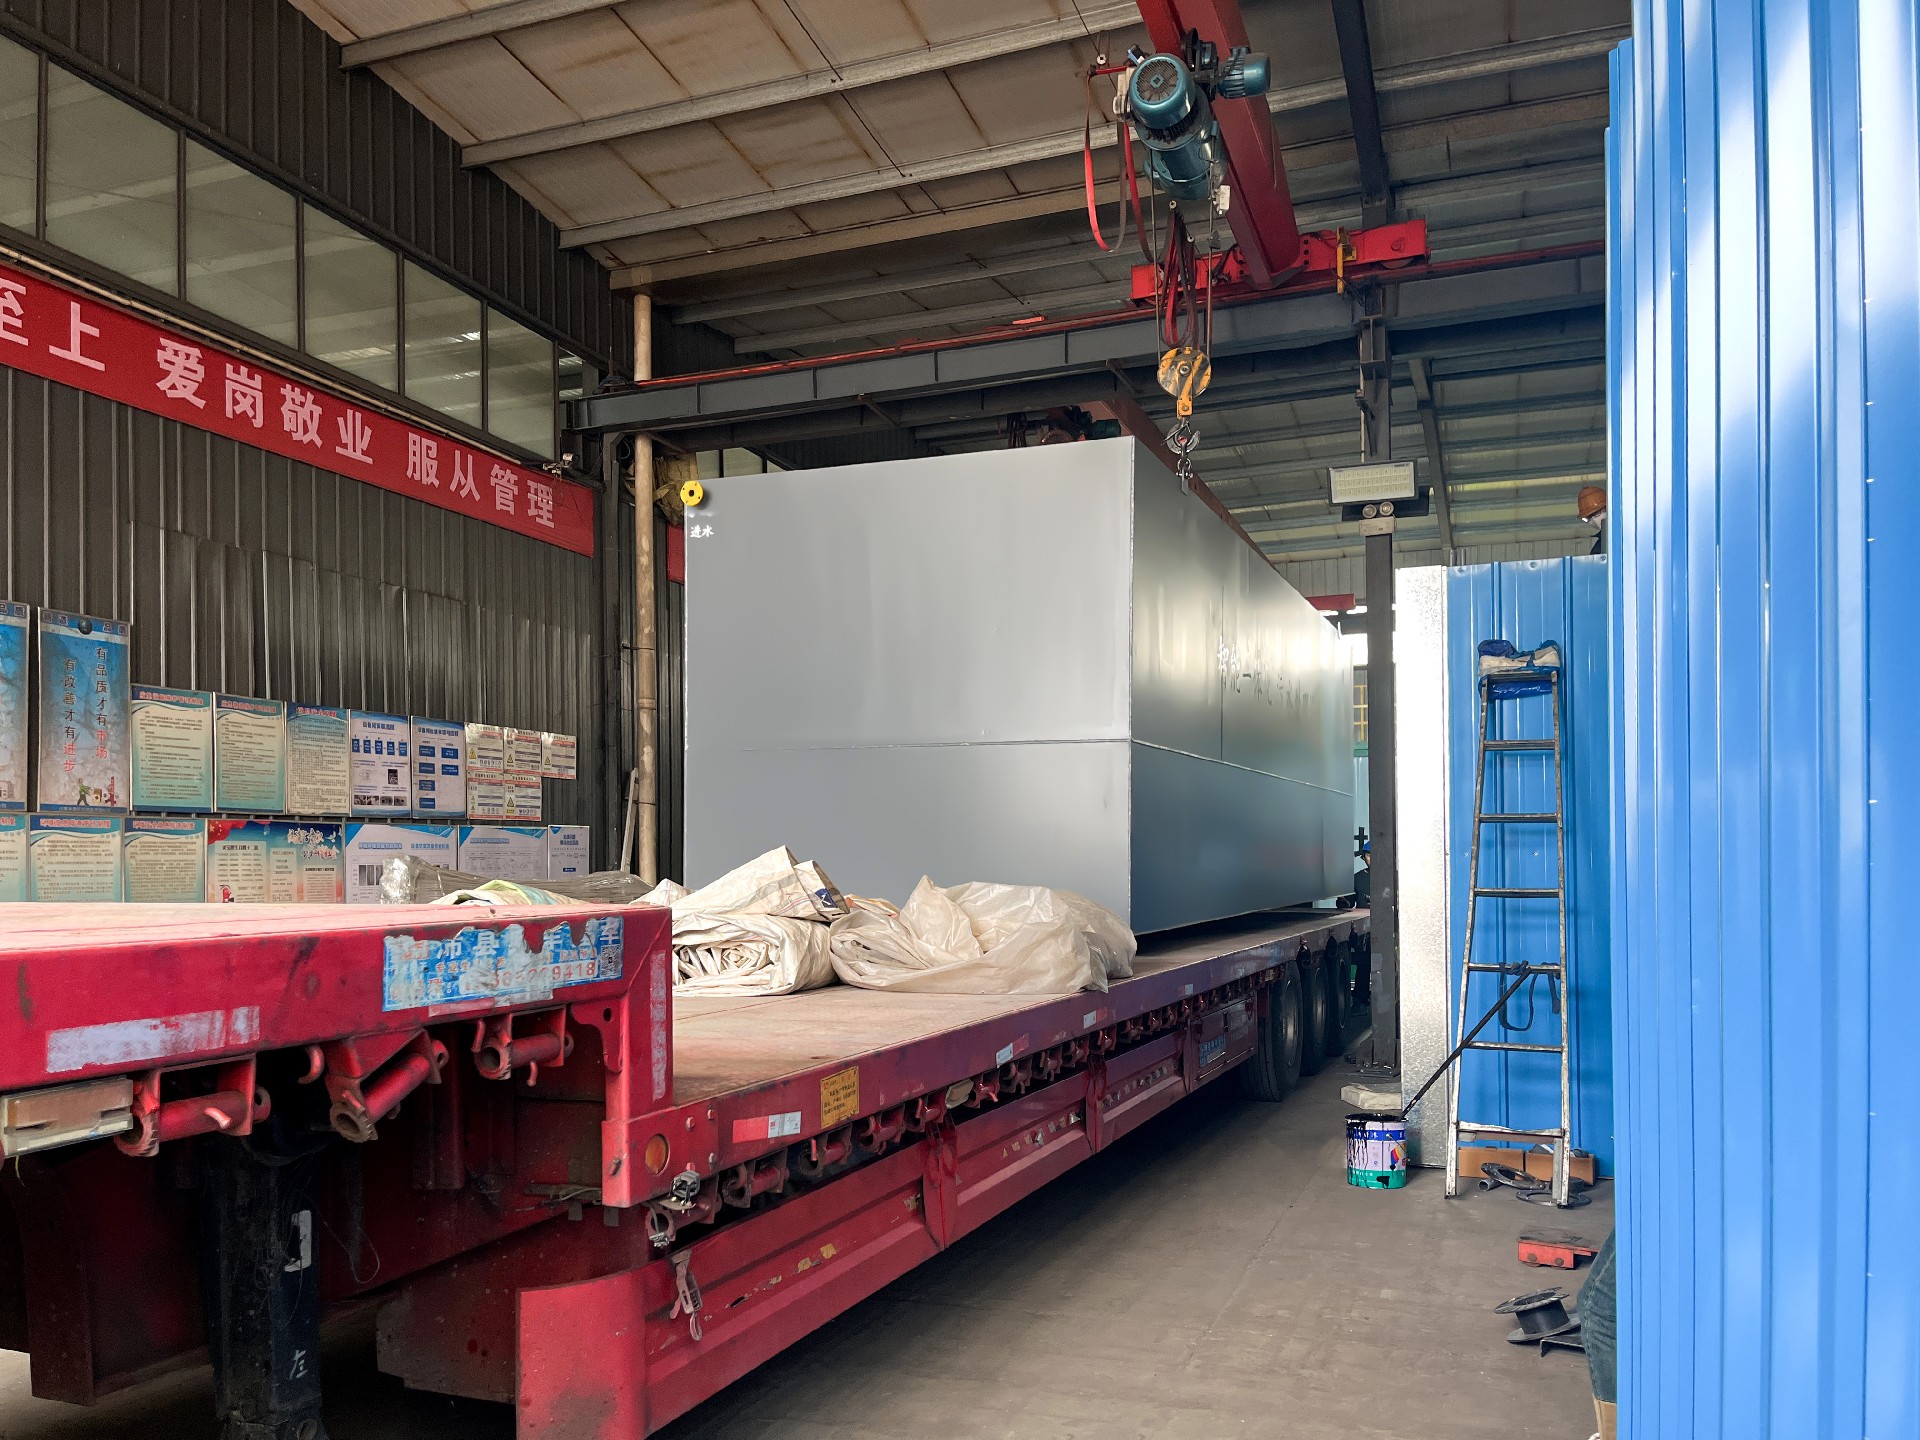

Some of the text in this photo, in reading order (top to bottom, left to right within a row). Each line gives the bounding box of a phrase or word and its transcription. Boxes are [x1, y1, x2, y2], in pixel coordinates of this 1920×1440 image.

[0, 277, 555, 529] 至上 爱岗敬业 服从管理
[63, 658, 77, 773] 有改善才有进步
[95, 647, 108, 759] 有品质才有市场
